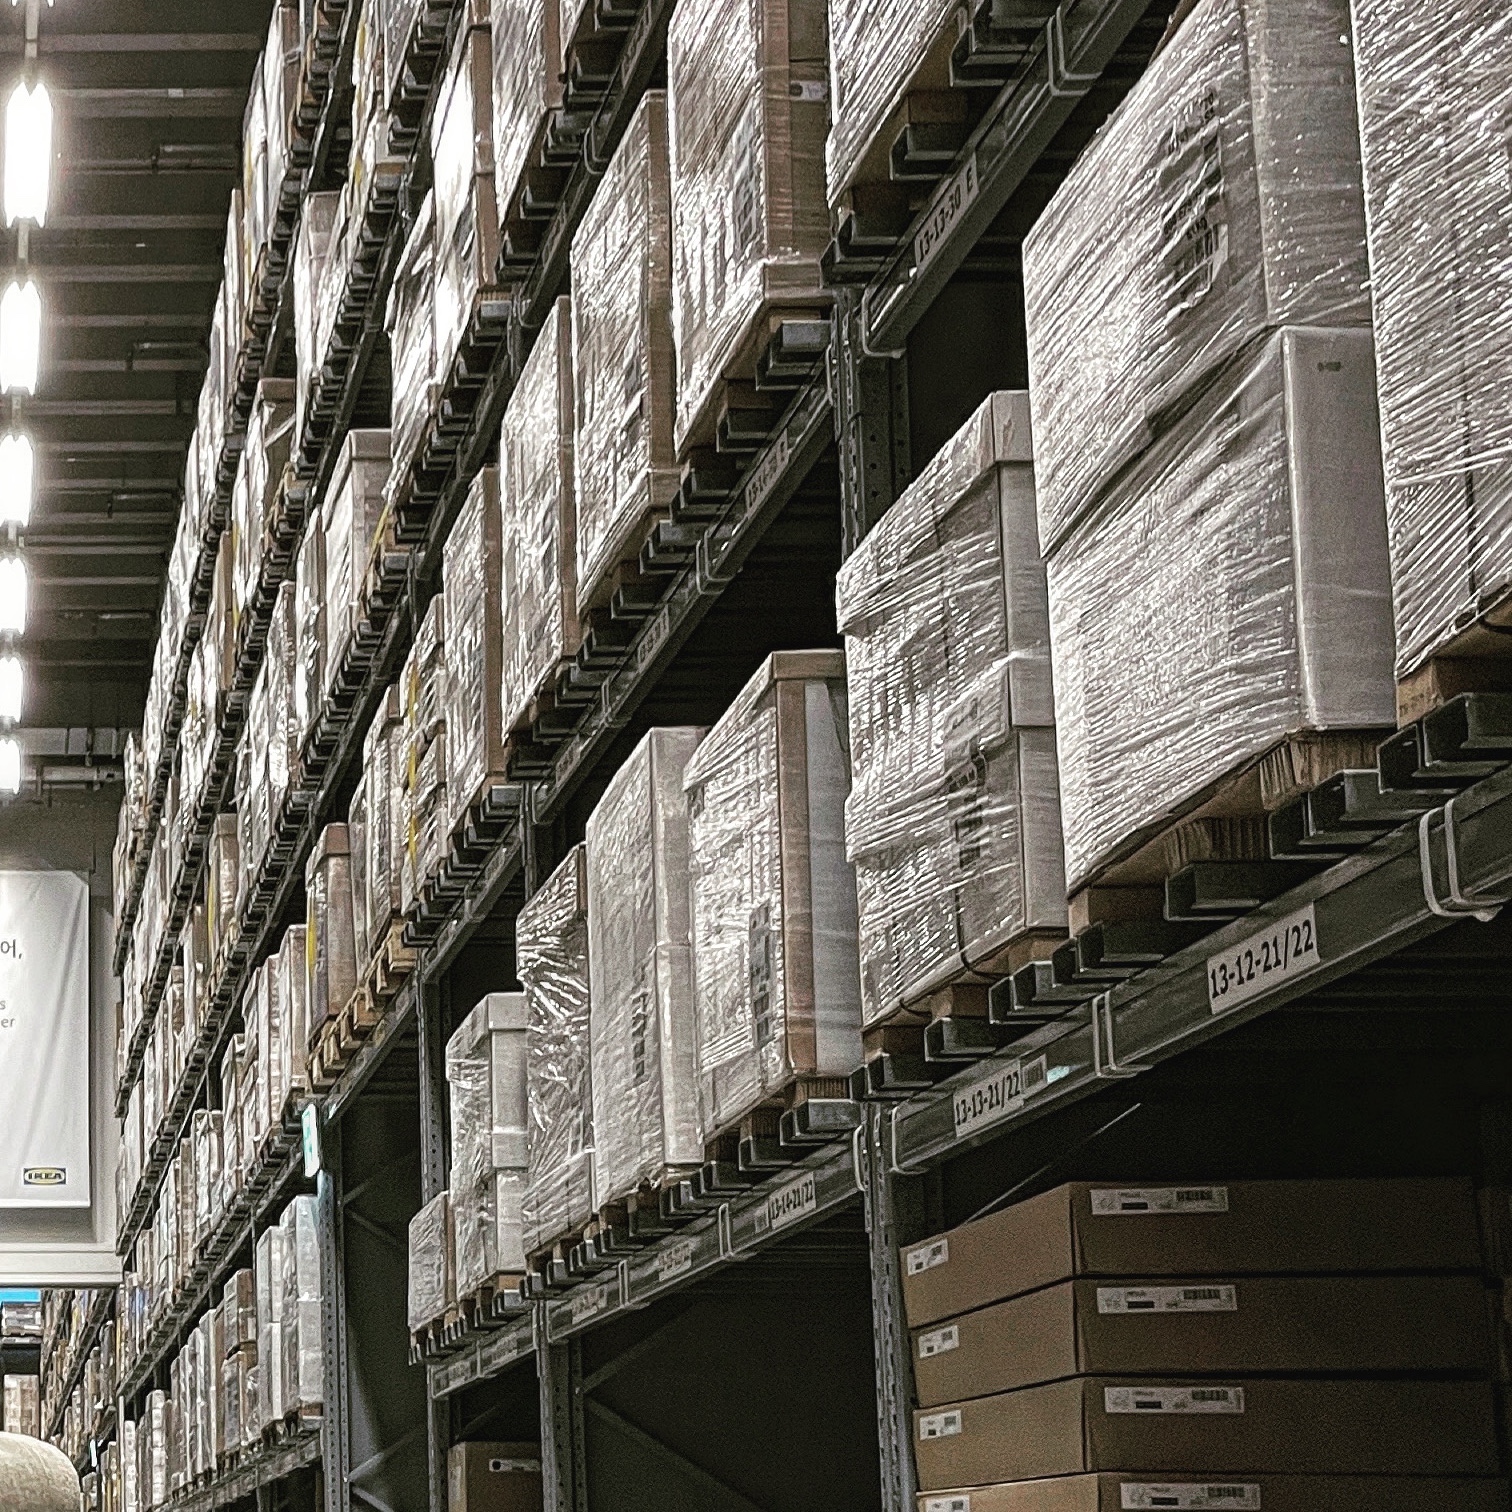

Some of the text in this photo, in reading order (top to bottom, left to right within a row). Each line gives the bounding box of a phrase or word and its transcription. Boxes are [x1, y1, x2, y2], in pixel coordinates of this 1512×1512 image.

[919, 166, 974, 263] 13-13-30 E
[1211, 919, 1314, 999] 13-12-21/22
[956, 1070, 1021, 1127] 13-13-21/22
